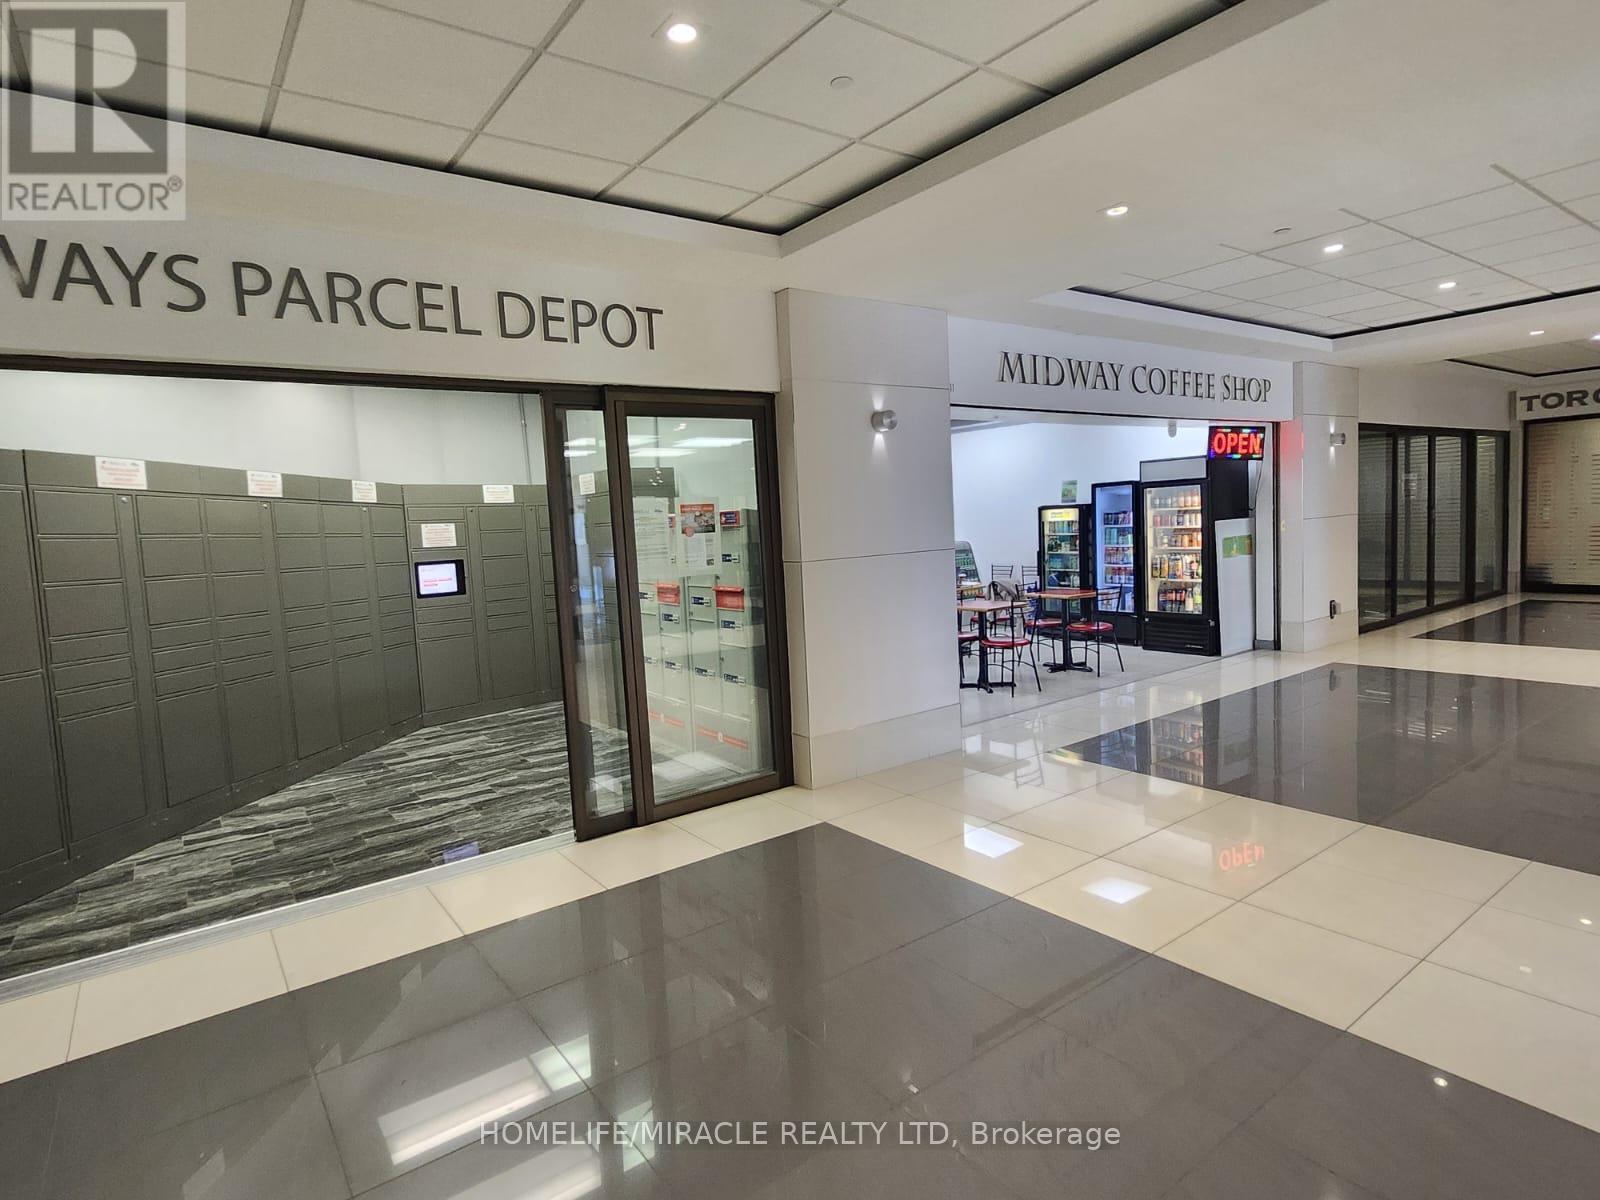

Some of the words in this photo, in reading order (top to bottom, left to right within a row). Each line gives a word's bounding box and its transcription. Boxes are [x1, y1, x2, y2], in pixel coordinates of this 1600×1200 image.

[232, 261, 481, 336] PARCEL
[498, 290, 664, 351] DEPOT
[998, 351, 1124, 392] MIDWAY
[1131, 364, 1215, 400] COFFEE
[1221, 374, 1272, 403] SHOP
[1213, 432, 1261, 455] OPEN
